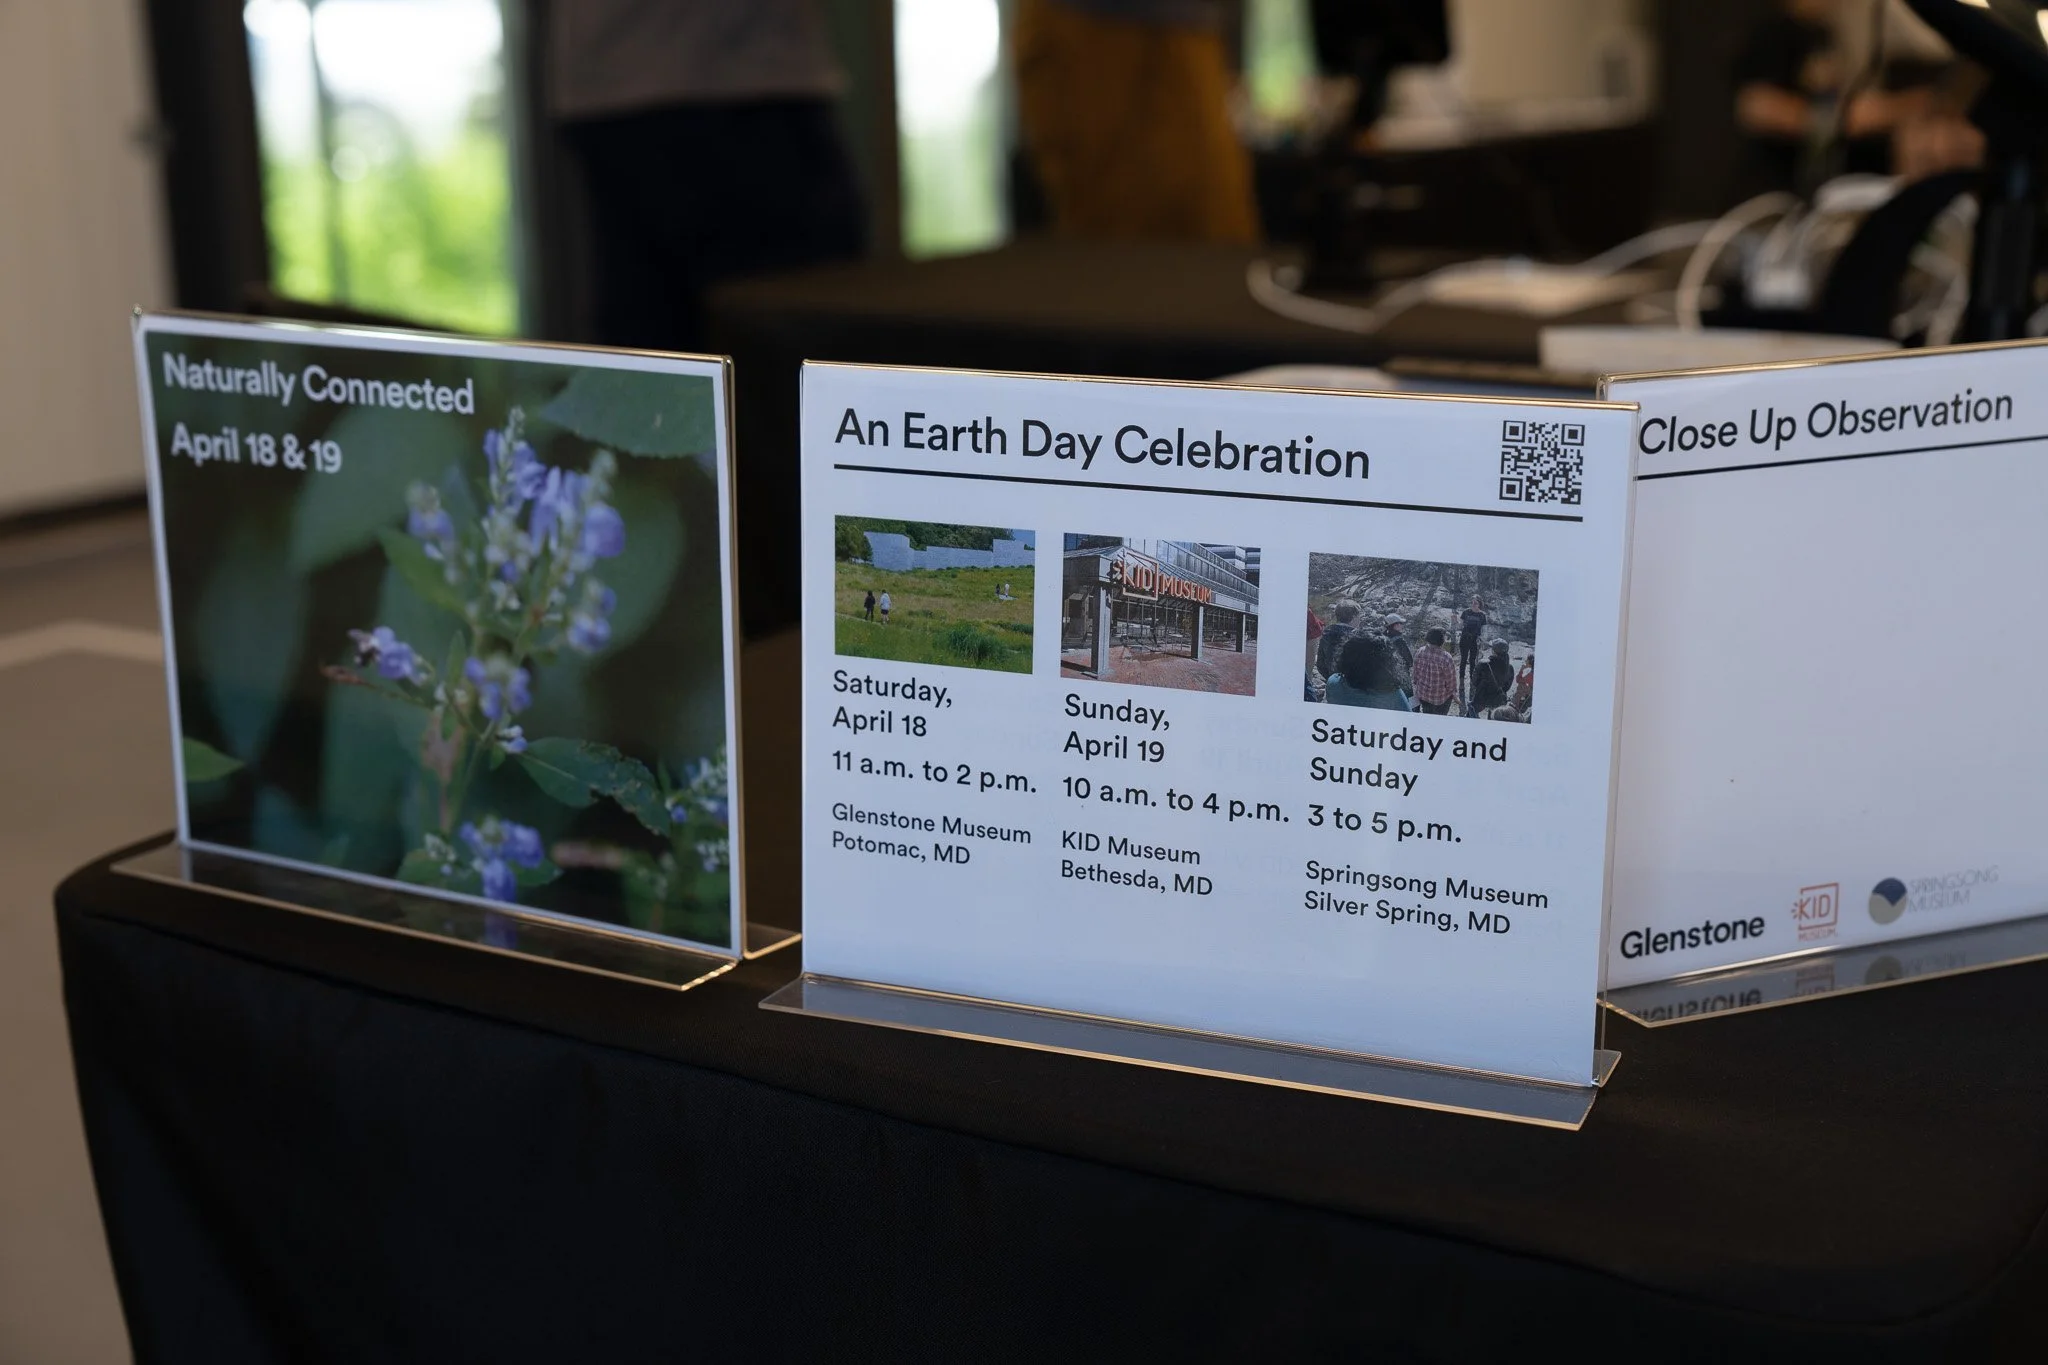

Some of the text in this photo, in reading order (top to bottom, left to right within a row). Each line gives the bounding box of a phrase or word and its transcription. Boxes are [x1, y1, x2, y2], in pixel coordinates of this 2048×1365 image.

[163, 352, 475, 415] Naturally Connected
[1638, 387, 2014, 454] Close Up Observation
[172, 422, 343, 474] April 18 & 19
[834, 407, 1370, 480] An Earth Day Celebration
[1123, 558, 1212, 605] KID MUSEUM
[833, 670, 952, 708] Saturday,
[832, 706, 927, 737] April 18
[1065, 693, 1169, 731] Sunday,
[1063, 731, 1164, 762] April 19
[1312, 719, 1443, 760] Saturday
[1453, 737, 1507, 762] and
[833, 750, 1036, 793] 11 a.m. to 2 p.m.
[1310, 757, 1418, 796] Sunday
[1063, 777, 1289, 822] 10 a.m. to 4 p.m.
[832, 803, 1031, 844] Glenstone Museum
[1308, 804, 1461, 843] 3 to 5 p.m.
[833, 831, 970, 864] Potomac, MD
[1063, 830, 1200, 865] KID Museum
[1062, 859, 1212, 895] Bethesda, MD
[1306, 860, 1548, 908] Springsong Museum
[1909, 865, 1999, 895] SPRINGSONG
[1305, 890, 1510, 934] Silver Spring, MD
[1798, 894, 1831, 921] KID
[1908, 889, 1970, 913] MUSEUM
[1620, 916, 1766, 960] Glenstone
